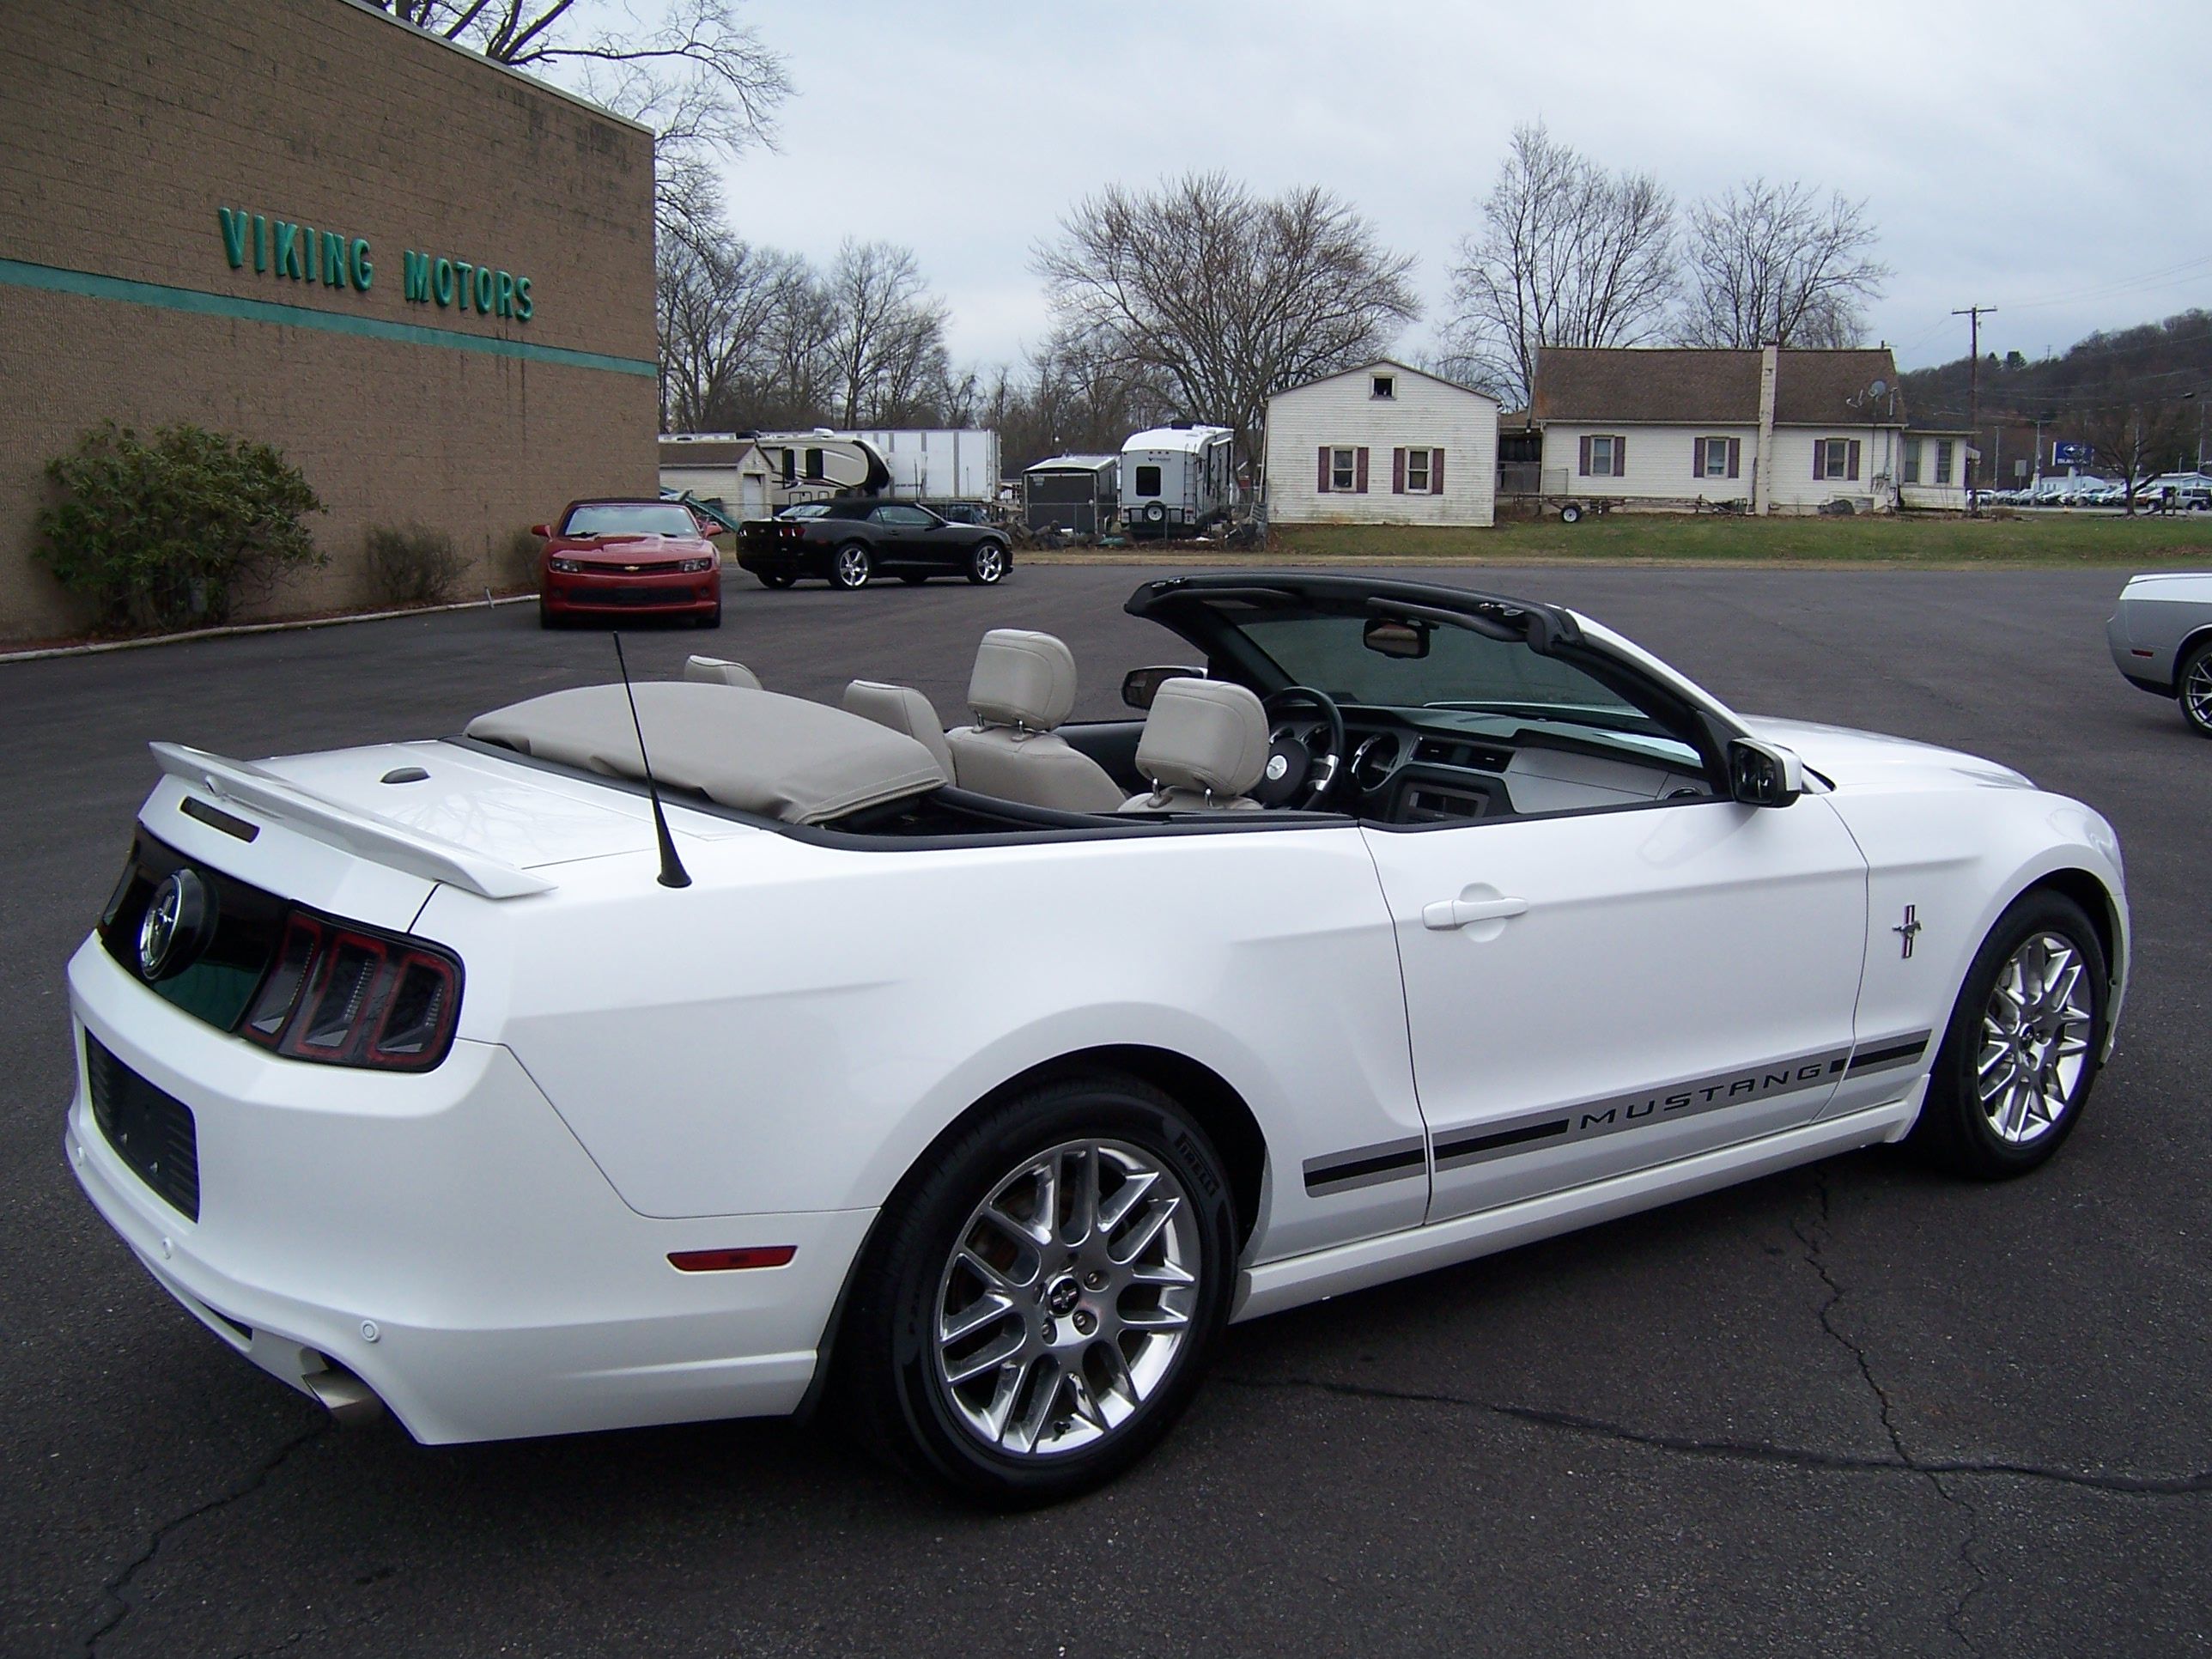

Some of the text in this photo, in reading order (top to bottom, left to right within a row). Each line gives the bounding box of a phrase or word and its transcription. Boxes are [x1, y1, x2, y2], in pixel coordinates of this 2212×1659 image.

[218, 206, 533, 322] VIKING MOTORS
[1580, 1063, 1821, 1130] MUSTANG
[1174, 1133, 1219, 1197] PIRELLI
